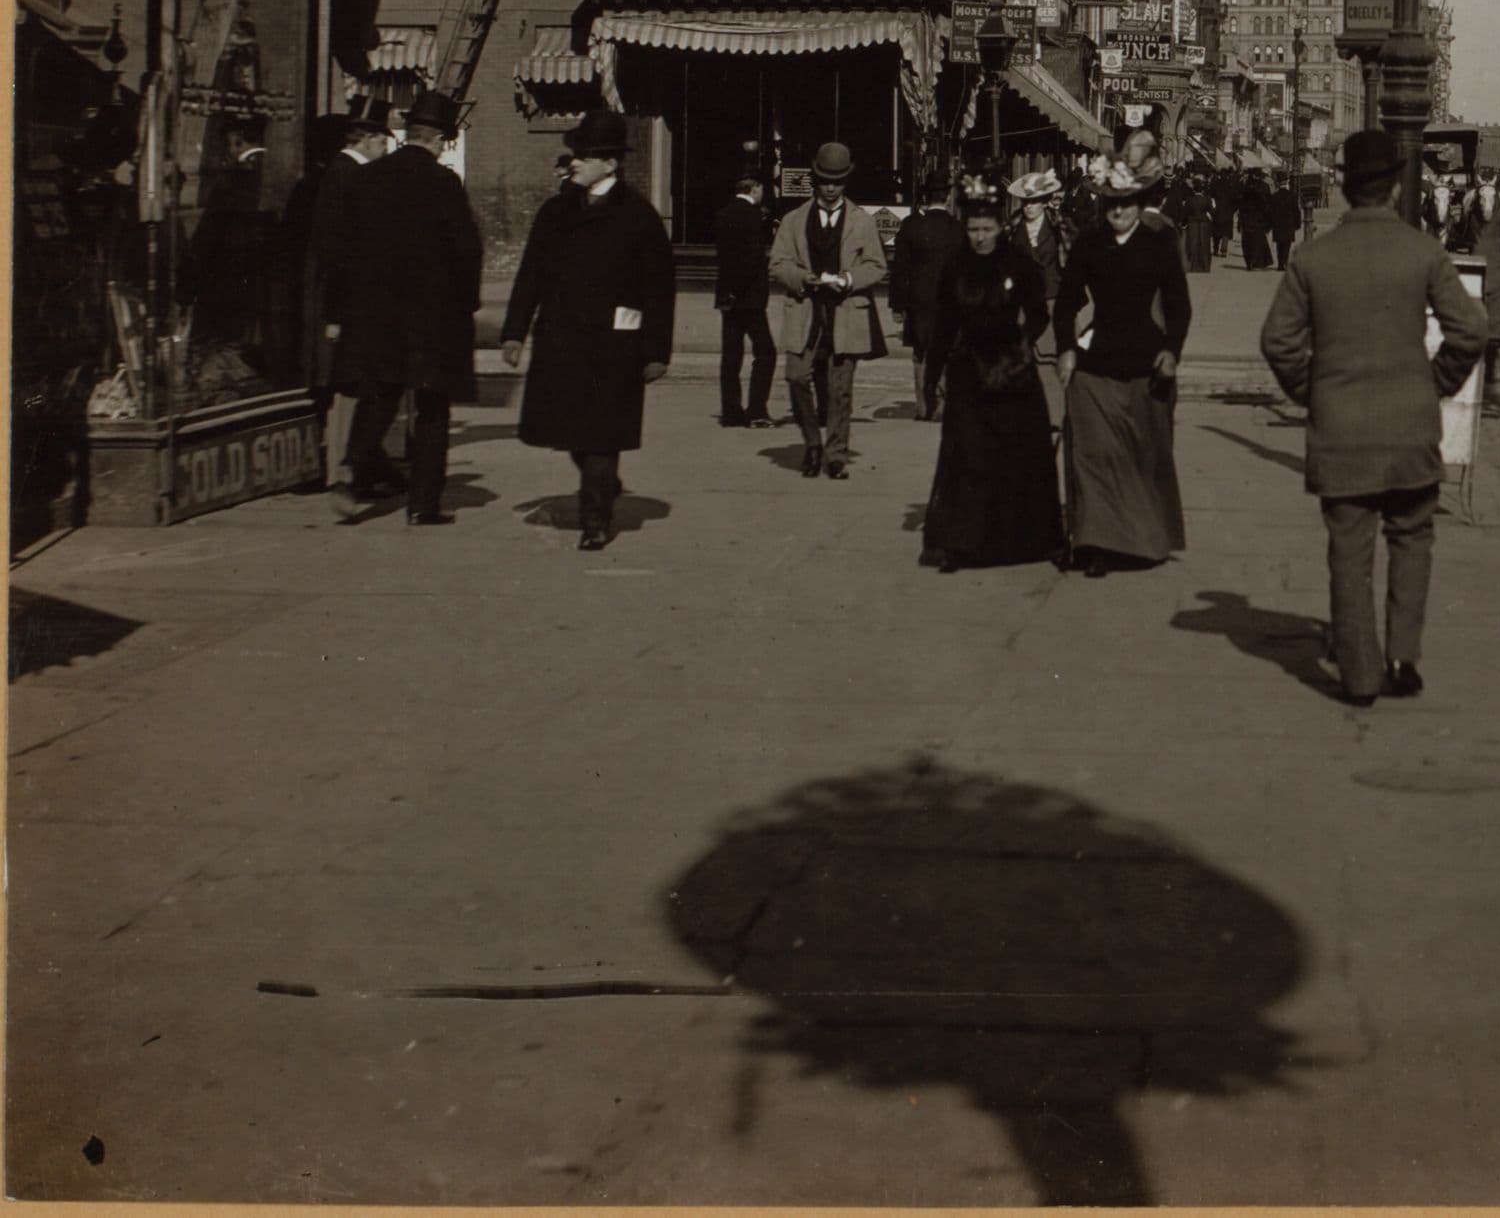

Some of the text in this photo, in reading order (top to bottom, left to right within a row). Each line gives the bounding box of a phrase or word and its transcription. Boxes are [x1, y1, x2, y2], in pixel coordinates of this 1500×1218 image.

[955, 5, 991, 17] MONEY
[1001, 8, 1033, 19] RDERS
[1120, 2, 1172, 23] SLAVE
[1117, 34, 1160, 42] BROADWAY
[1102, 77, 1138, 92] POOL
[177, 424, 321, 510] COLD SODA
